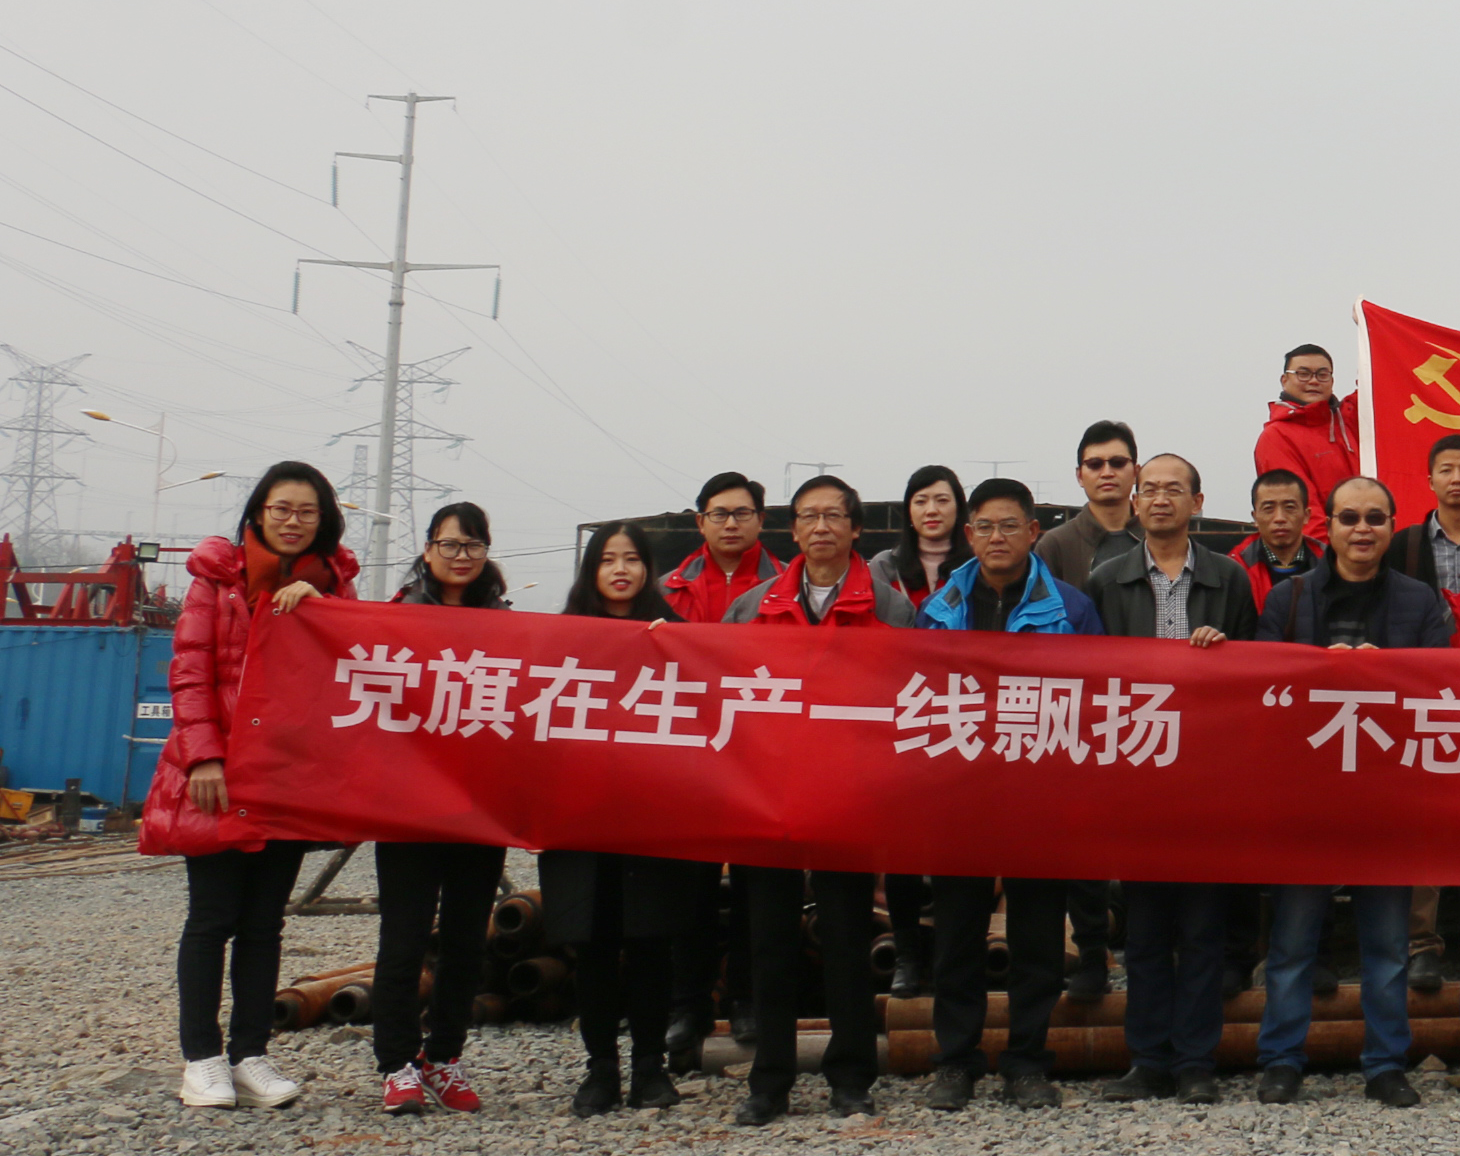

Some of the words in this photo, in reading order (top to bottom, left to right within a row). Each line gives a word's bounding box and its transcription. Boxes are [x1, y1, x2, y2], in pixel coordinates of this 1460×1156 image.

[140, 705, 172, 717] 工具箱
[331, 644, 1181, 768] 党旗在生产一线飘扬
